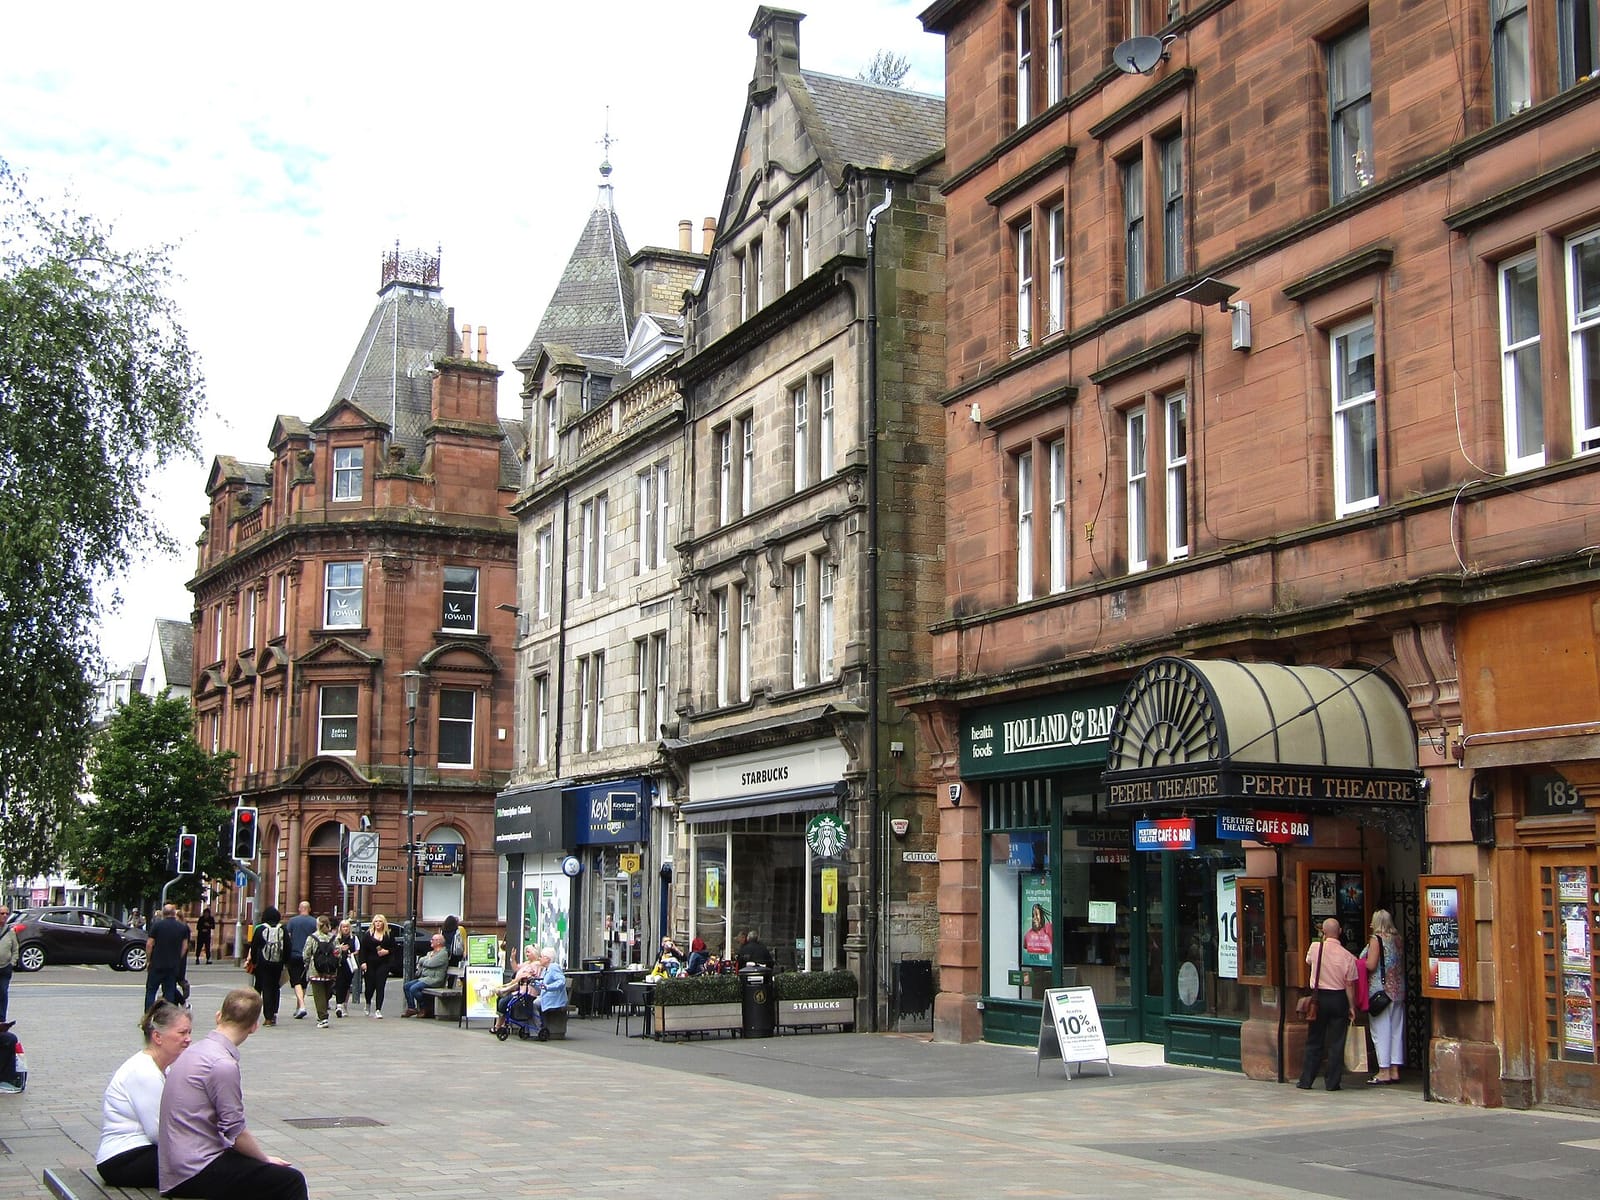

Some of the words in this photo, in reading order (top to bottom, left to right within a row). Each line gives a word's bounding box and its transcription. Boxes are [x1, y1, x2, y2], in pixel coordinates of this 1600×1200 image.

[332, 608, 360, 616] rowan
[444, 612, 472, 622] rowan
[972, 724, 994, 740] health
[1003, 714, 1068, 754] HOLLAND
[1070, 710, 1085, 746] &
[972, 742, 993, 758] foods
[742, 766, 788, 786] STARBUCKS
[1110, 782, 1154, 804] PERTH
[1156, 775, 1218, 800] THEATRE
[1242, 774, 1313, 796] PERTH
[1322, 778, 1415, 800] THEATRE
[1544, 781, 1578, 806] 183
[1158, 826, 1172, 842] CAFÉ
[1172, 829, 1177, 841] &
[1178, 828, 1191, 842] BAR
[1222, 816, 1245, 824] PERTH
[1256, 818, 1279, 834] CAFÉ
[1281, 823, 1288, 834] &
[1290, 824, 1310, 836] BAR
[1222, 824, 1255, 833] THEATRE
[793, 1002, 840, 1010] STARBUCKS
